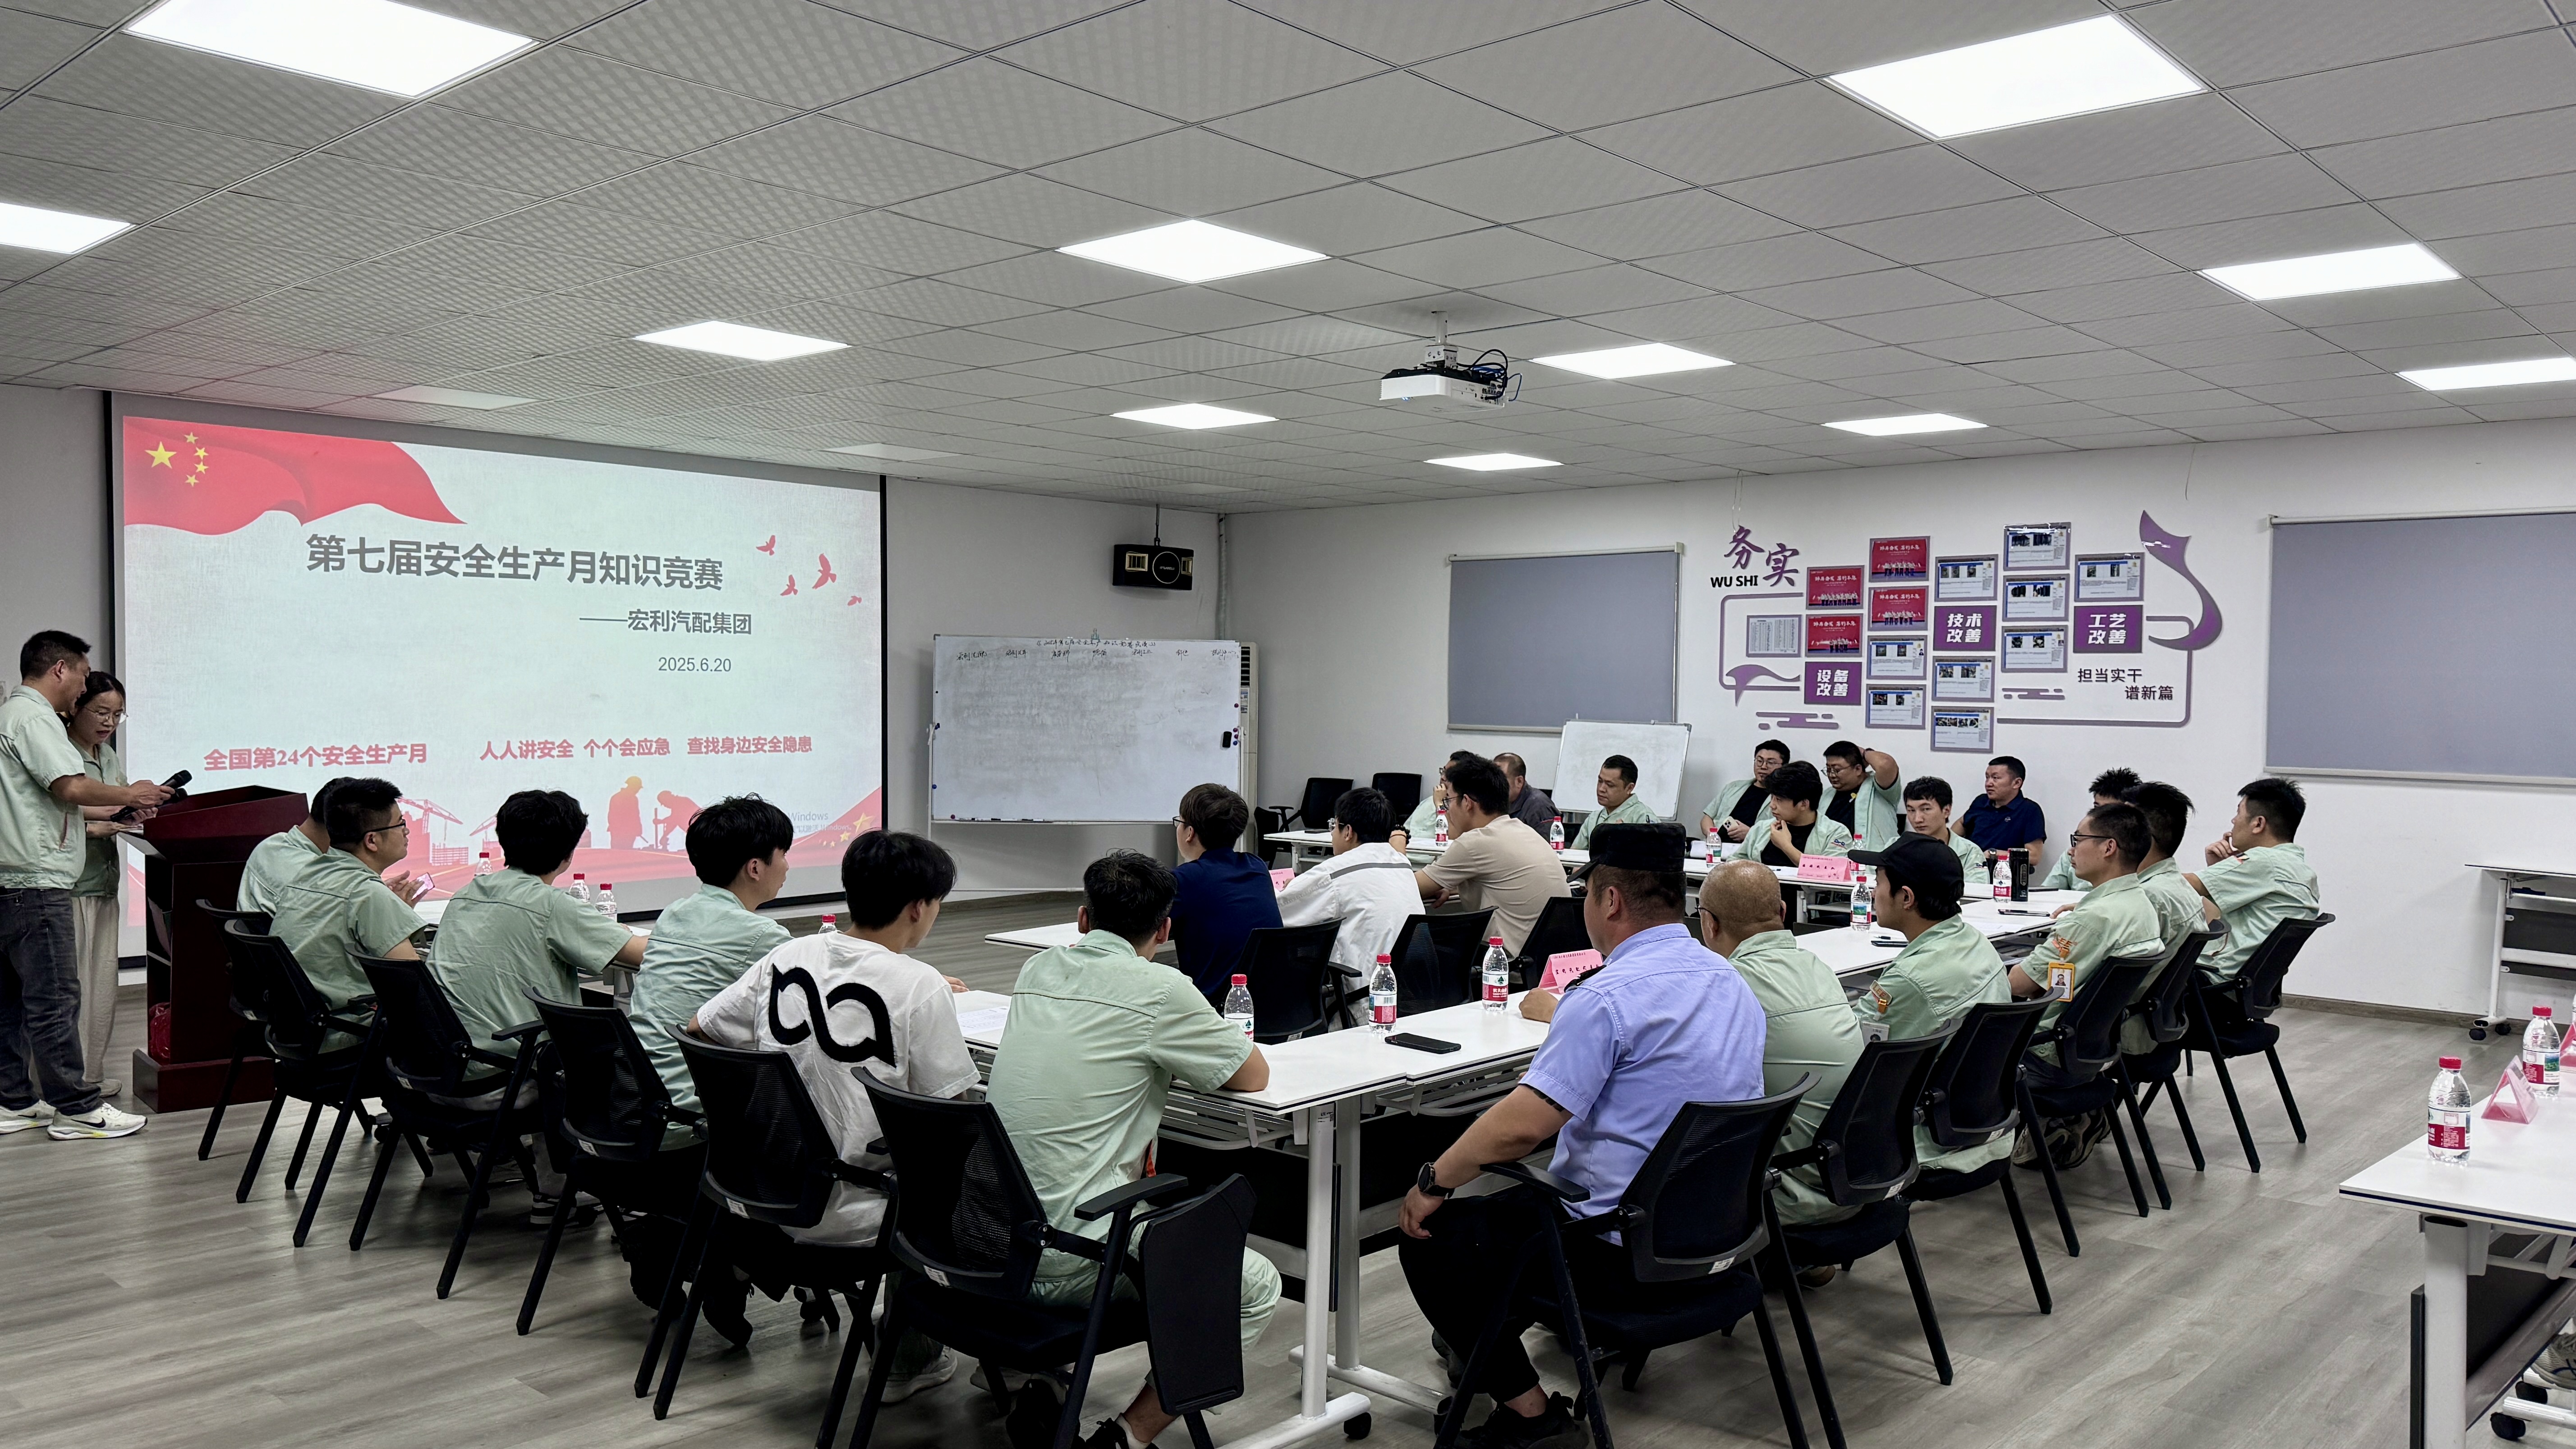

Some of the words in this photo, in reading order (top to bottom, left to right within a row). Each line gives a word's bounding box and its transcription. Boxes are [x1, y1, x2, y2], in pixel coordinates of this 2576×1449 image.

[306, 534, 723, 590] 第七届安全生产月知识竞赛
[1724, 525, 1799, 587] 务实
[1711, 576, 1732, 588] WU
[1736, 575, 1758, 586] SHI
[1947, 614, 1982, 627] 技术
[2088, 614, 2126, 627] 工艺
[1946, 629, 1981, 643] 改善
[2088, 630, 2126, 644] 改善
[658, 657, 731, 672] 2025.6.20
[1817, 670, 1849, 682] 设备
[2078, 668, 2142, 683] 担当实干
[1816, 683, 1848, 696] 改善
[2125, 685, 2173, 700] 谱新篇
[480, 739, 574, 760] 人人讲安全
[584, 737, 671, 758] 个个会应急
[687, 736, 812, 755] 查找身边安全隐患
[204, 743, 427, 770] 全国第24个安全生产月
[788, 812, 828, 821] Windows
